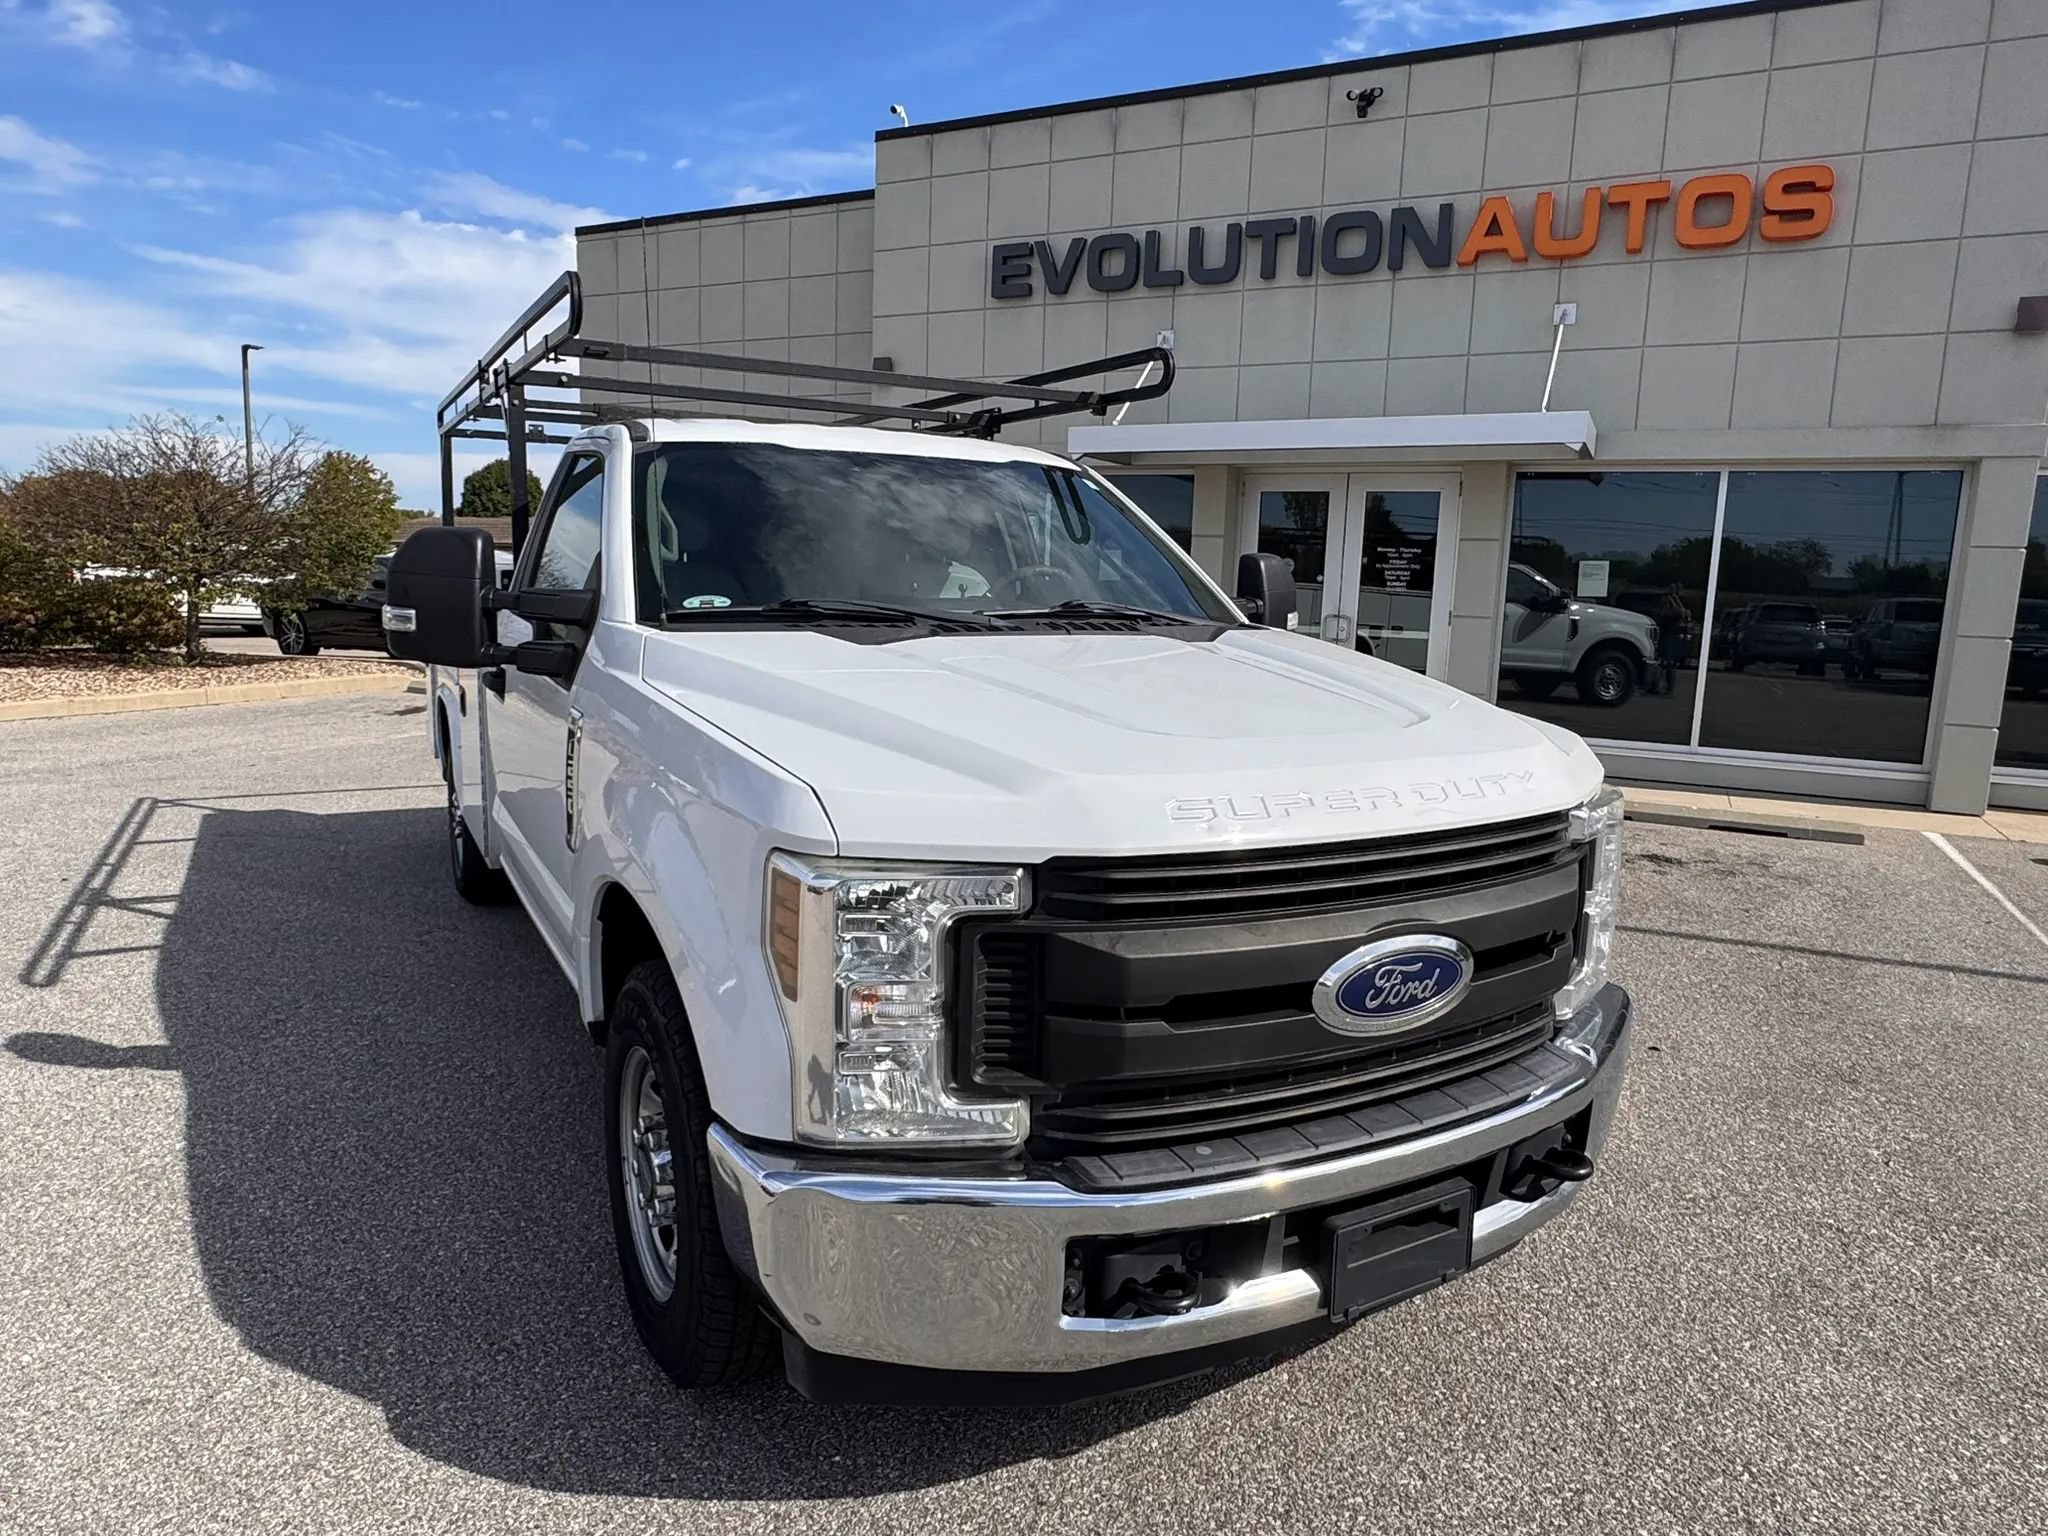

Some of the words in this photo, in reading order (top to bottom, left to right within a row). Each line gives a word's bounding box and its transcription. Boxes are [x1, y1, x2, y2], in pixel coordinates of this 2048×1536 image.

[1165, 789, 1402, 823] SUPER
[1408, 769, 1534, 804] DUTY
[1365, 962, 1440, 1009] Ford
